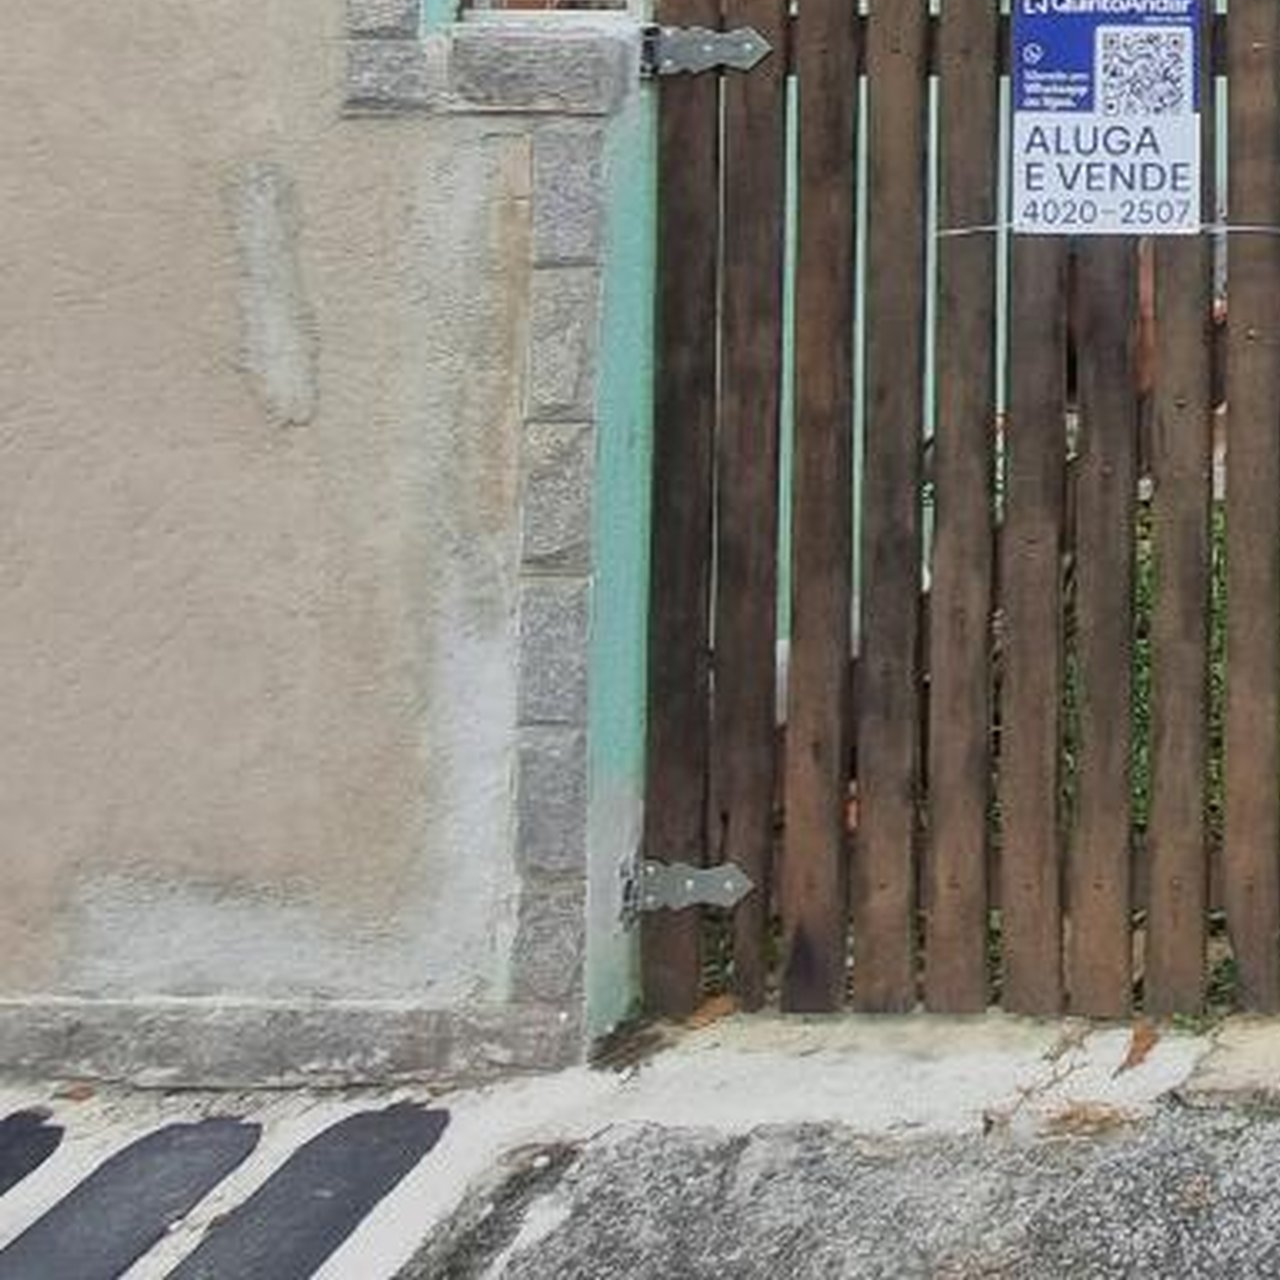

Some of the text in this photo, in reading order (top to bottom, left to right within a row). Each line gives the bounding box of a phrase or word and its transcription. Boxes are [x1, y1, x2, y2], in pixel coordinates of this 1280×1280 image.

[1025, 126, 1160, 156] ALUGA
[1025, 163, 1192, 191] E VENDE
[1022, 201, 1190, 224] 4020-2507
